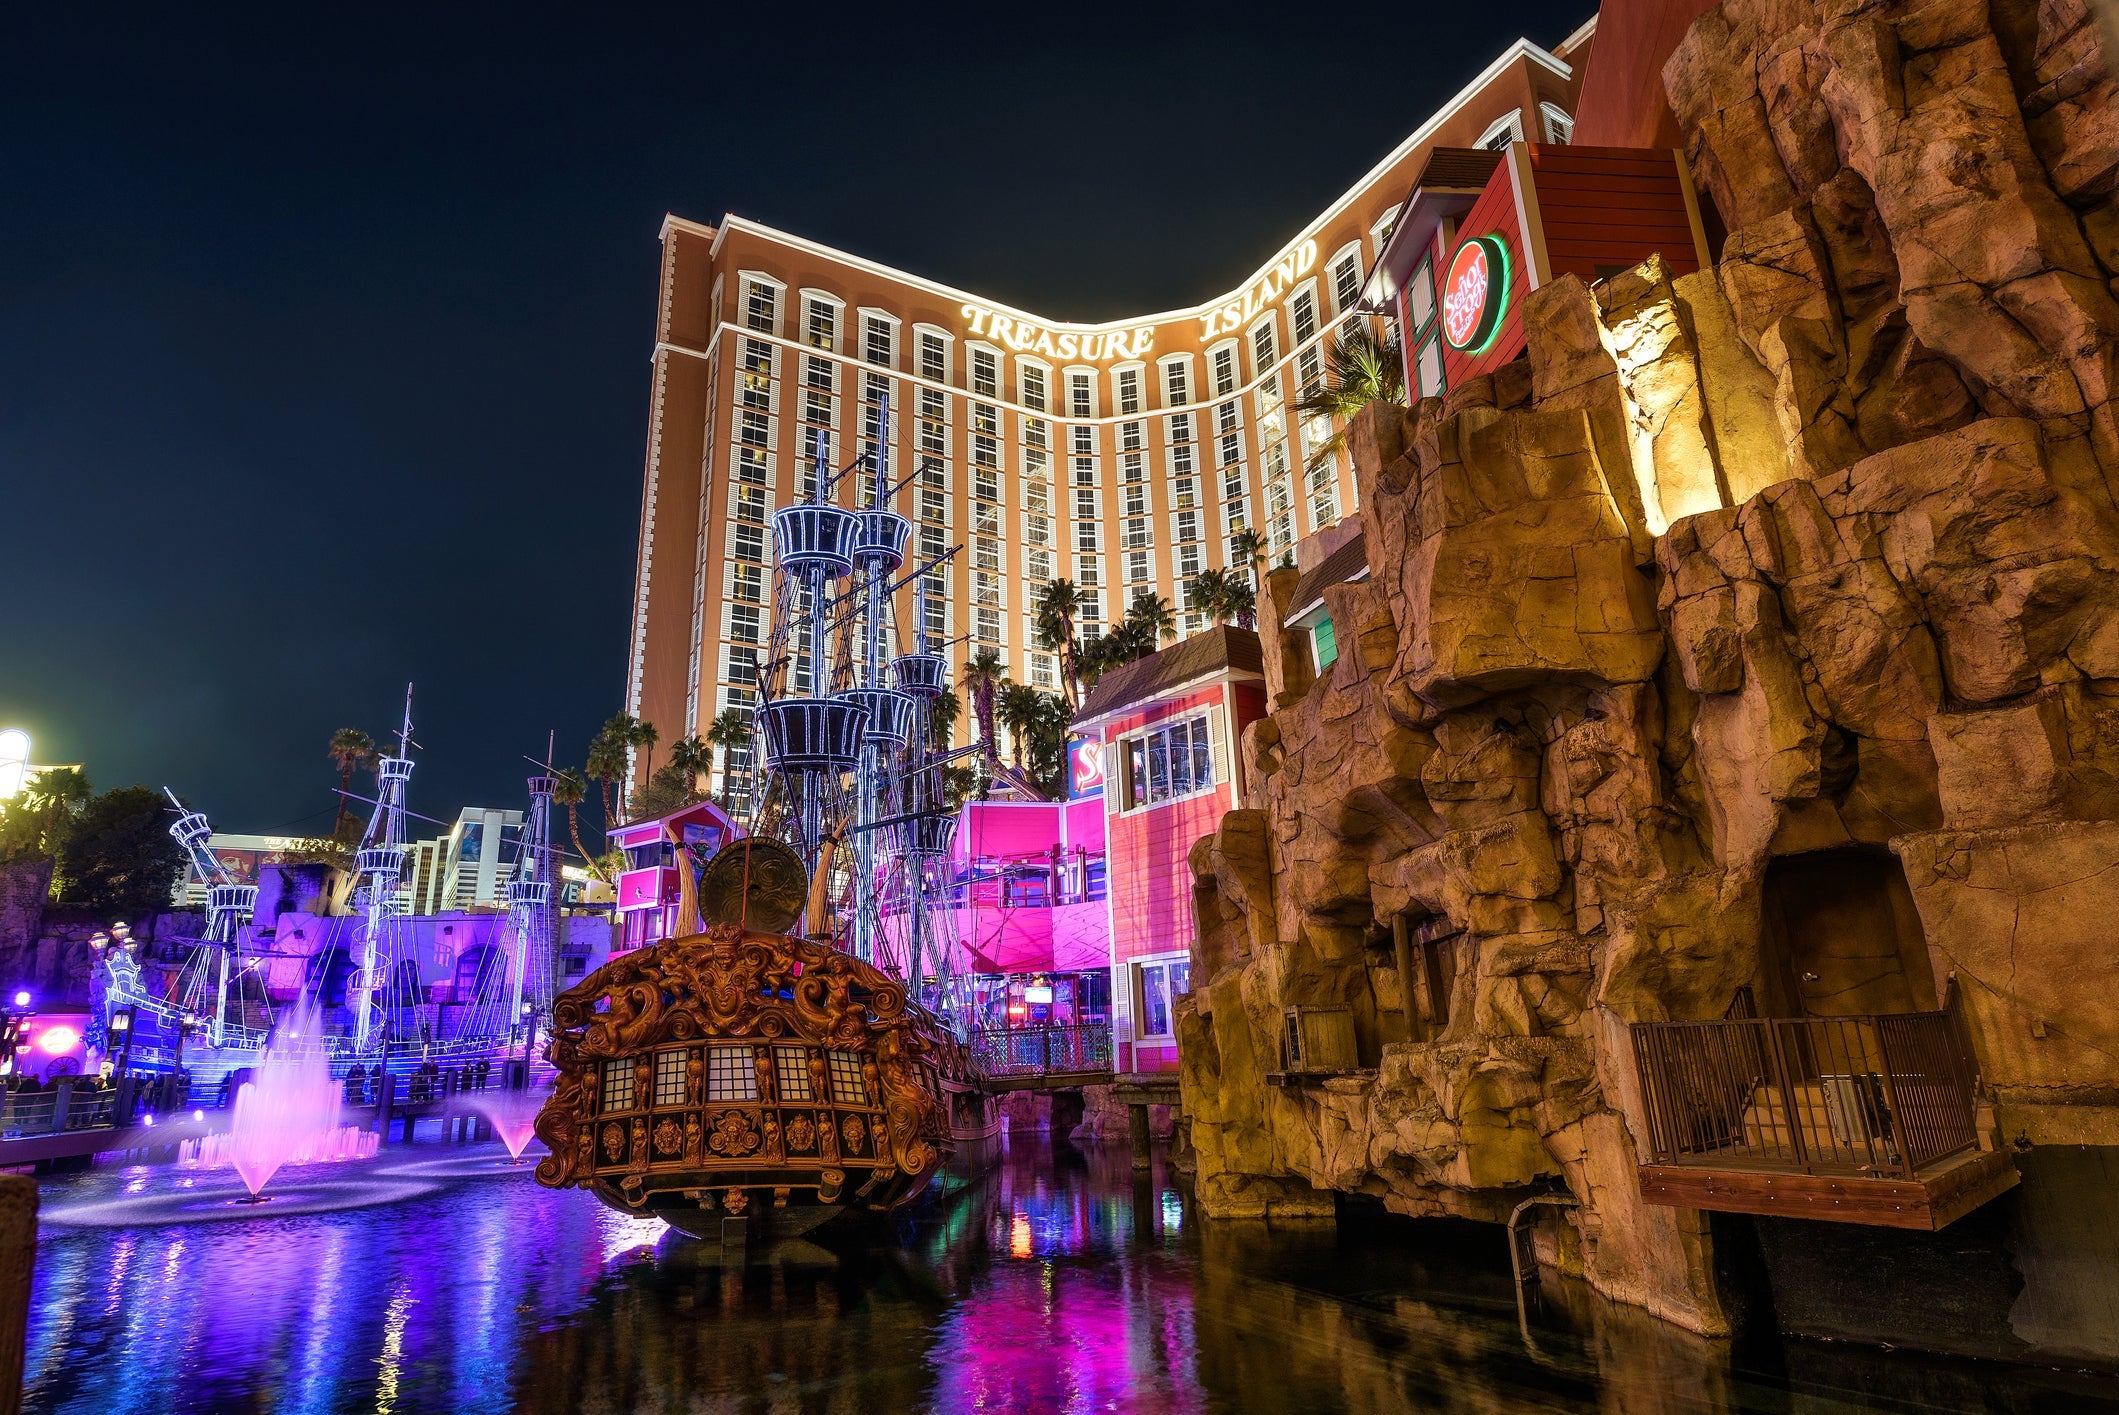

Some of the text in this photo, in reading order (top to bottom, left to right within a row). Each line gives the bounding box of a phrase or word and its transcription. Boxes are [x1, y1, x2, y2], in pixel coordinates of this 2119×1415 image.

[960, 238, 1318, 361] TREASURE ISLAND
[1446, 252, 1483, 325] Señor
